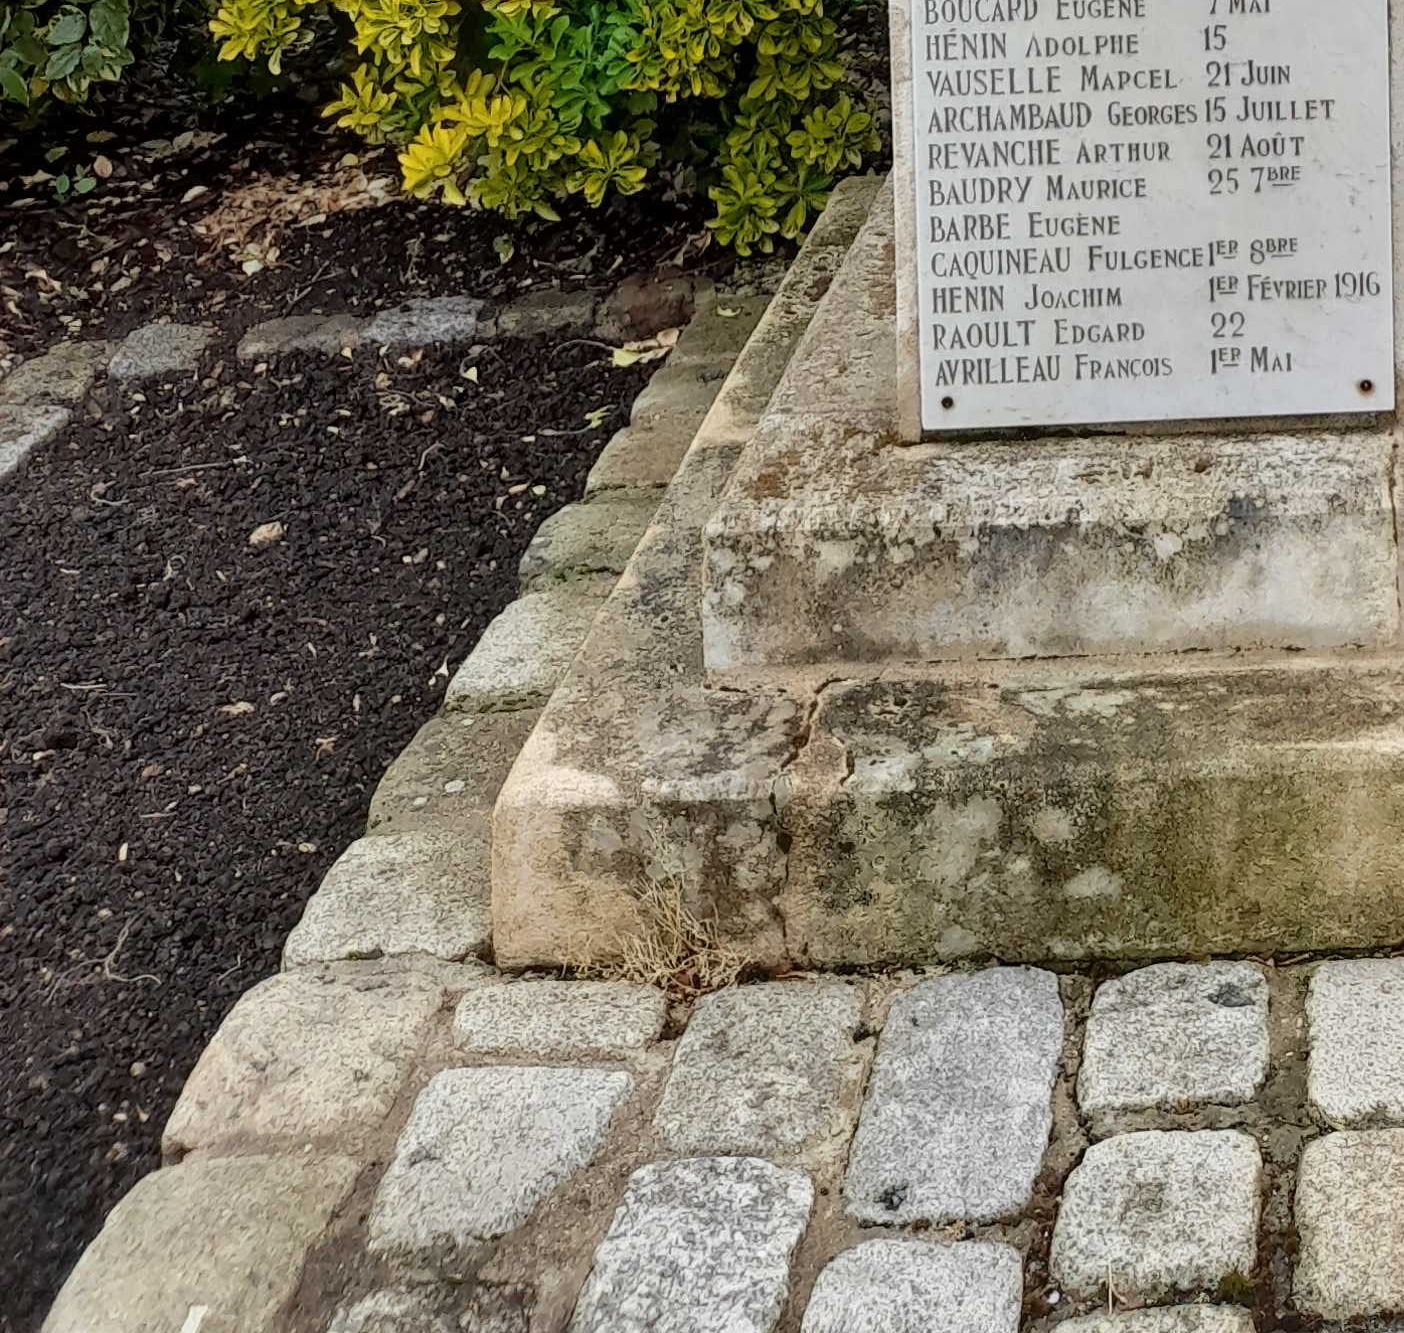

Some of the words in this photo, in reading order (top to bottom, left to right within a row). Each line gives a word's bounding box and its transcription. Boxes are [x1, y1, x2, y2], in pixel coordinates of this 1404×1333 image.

[926, 28, 1006, 61] HÉNIN
[1026, 34, 1138, 58] ADOLPHE
[1204, 25, 1227, 51] 15
[926, 66, 1061, 97] VAUSELLE
[1081, 65, 1178, 92] MARCEL
[1206, 61, 1230, 87] 21
[1241, 60, 1290, 86] JUIN
[928, 102, 1092, 133] ARCHAMBAUD
[1108, 101, 1197, 127] GEORGES
[1205, 96, 1226, 123] 15
[1236, 96, 1335, 121] JUILLET
[928, 139, 1061, 170] REVANCHE
[1076, 141, 1170, 164] ARTHUR
[1207, 133, 1232, 160] 21
[1241, 132, 1304, 158] AOÛT
[929, 176, 1032, 206] BAUDRY
[1047, 175, 1147, 201] MAURICE
[1208, 168, 1239, 195] 25
[930, 213, 1011, 243] BARBE
[1028, 212, 1120, 238] EUGÈNE
[931, 247, 1070, 280] CAQUINEAU
[1088, 245, 1203, 272] FULGENCE
[932, 285, 1004, 314] HENIN
[1025, 284, 1122, 310] JOACHIM
[1335, 271, 1380, 298] 1916
[933, 320, 1036, 350] RAOULT
[1054, 319, 1145, 345] EDGARD
[1211, 312, 1245, 338] 22
[935, 355, 1060, 386] AVRILLEAU
[1075, 354, 1172, 380] FRANÇOIS
[1251, 346, 1292, 373] MAI
